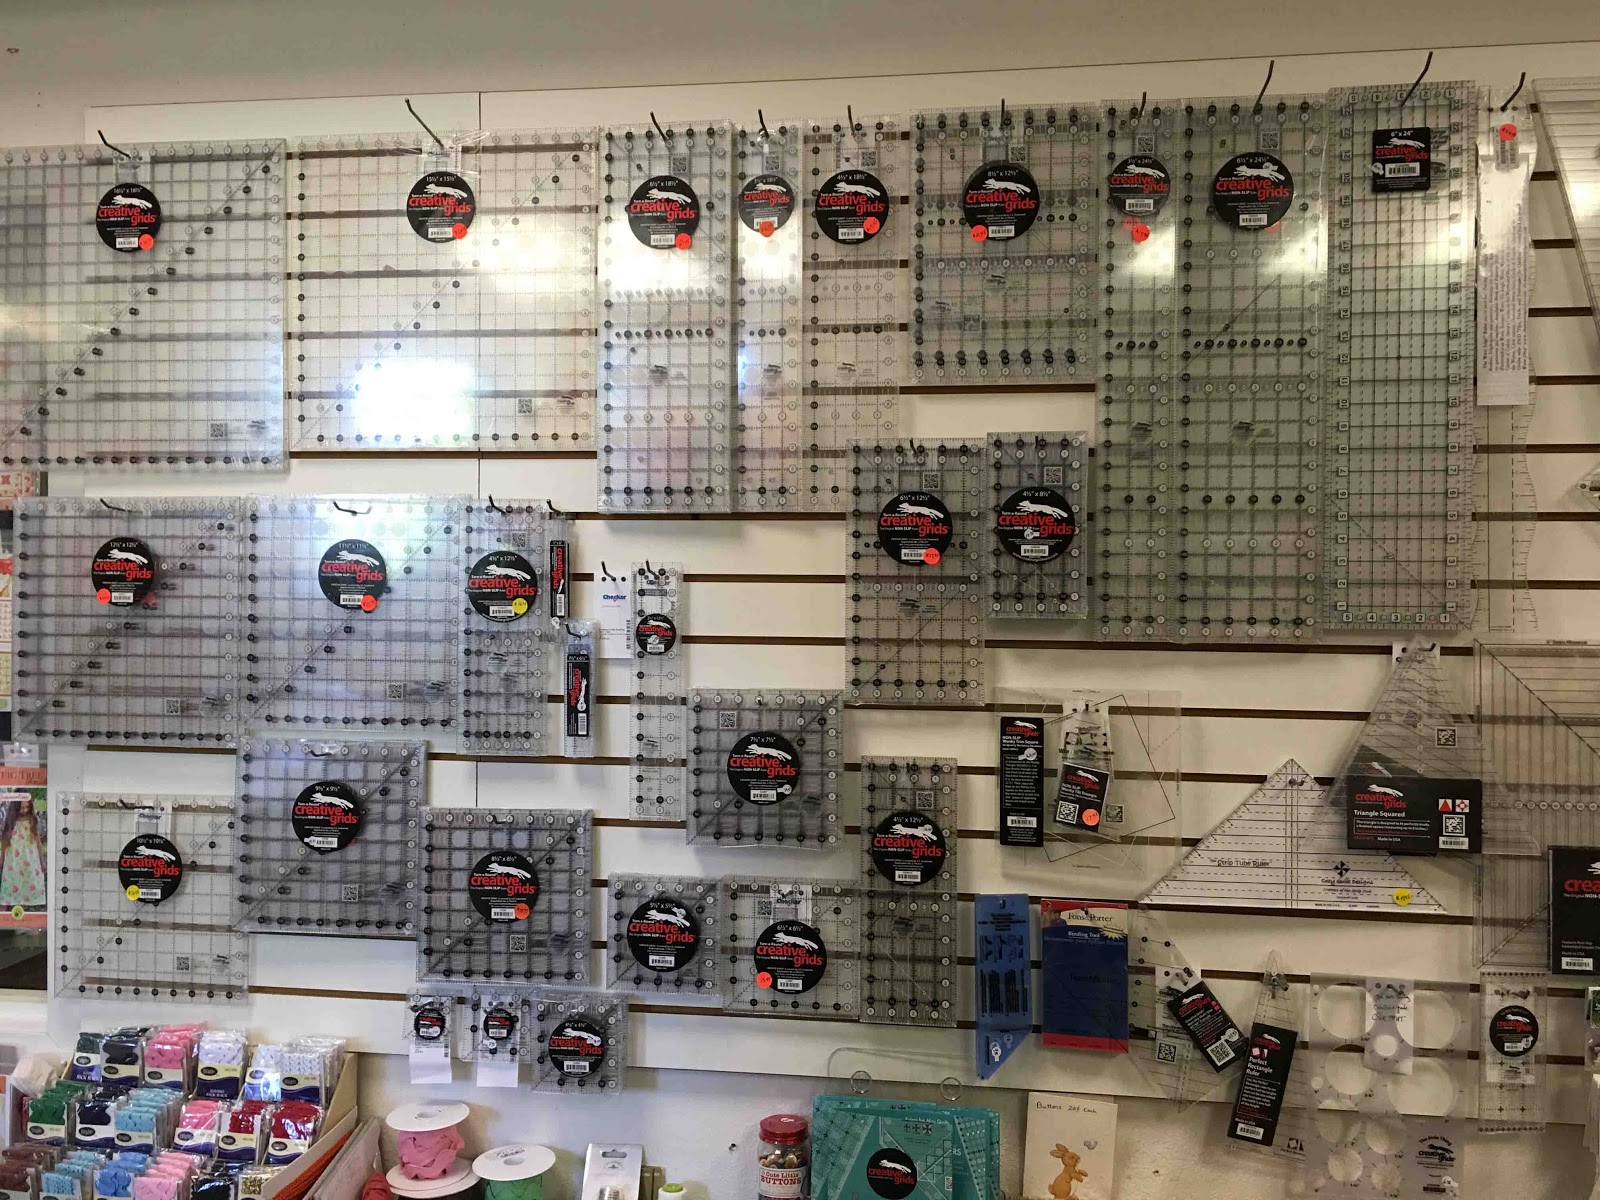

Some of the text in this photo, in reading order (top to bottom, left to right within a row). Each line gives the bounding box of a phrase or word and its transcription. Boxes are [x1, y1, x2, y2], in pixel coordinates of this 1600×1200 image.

[1375, 146, 1416, 156] creative
[1405, 151, 1428, 161] grids
[1111, 172, 1153, 184] creative
[1216, 176, 1271, 190] creative
[1142, 181, 1168, 192] grids
[1257, 184, 1290, 200] grids
[744, 188, 778, 201] creative
[818, 193, 869, 206] creative
[966, 187, 1018, 200] creative
[409, 196, 455, 207] creative
[630, 200, 680, 212] creative
[769, 196, 790, 206] grids
[1005, 194, 1036, 210] grids
[98, 205, 141, 217] creative
[444, 203, 471, 215] grids
[667, 206, 696, 221] grids
[856, 201, 884, 215] grids
[130, 213, 156, 225] grids
[880, 513, 931, 526] creative
[997, 512, 1053, 526] creative
[918, 522, 948, 537] grids
[1039, 520, 1073, 536] grids
[94, 559, 137, 570] creative
[321, 560, 369, 573] creative
[125, 567, 152, 580] grids
[356, 570, 384, 582] grids
[468, 575, 519, 588] creative
[506, 582, 535, 598] grids
[638, 625, 663, 633] creative
[730, 756, 780, 769] creative
[767, 763, 796, 778] grids
[1067, 774, 1094, 783] creative
[1355, 793, 1394, 801] creative
[295, 803, 343, 815] creative
[1384, 800, 1408, 809] grids
[330, 812, 358, 826] grids
[874, 834, 925, 847] creative
[911, 844, 942, 858] grids
[121, 857, 164, 867] creative
[153, 863, 179, 877] grids
[470, 873, 520, 886] creative
[507, 882, 535, 896] grids
[629, 921, 680, 934] creative
[665, 930, 695, 944] grids
[756, 943, 807, 956] creative
[794, 952, 823, 966] grids
[1519, 1023, 1532, 1032] grids
[550, 1037, 589, 1047] creative
[579, 1044, 602, 1055] grids
[1249, 1056, 1267, 1065] Perfect
[1248, 1063, 1273, 1073] Rectangle
[1036, 1102, 1062, 1110] Buttons
[1440, 1136, 1452, 1146] Thing
[1438, 1154, 1456, 1162] grids
[868, 1167, 904, 1176] creative
[761, 1177, 801, 1185] BUTTONS
[893, 1175, 914, 1185] grids
